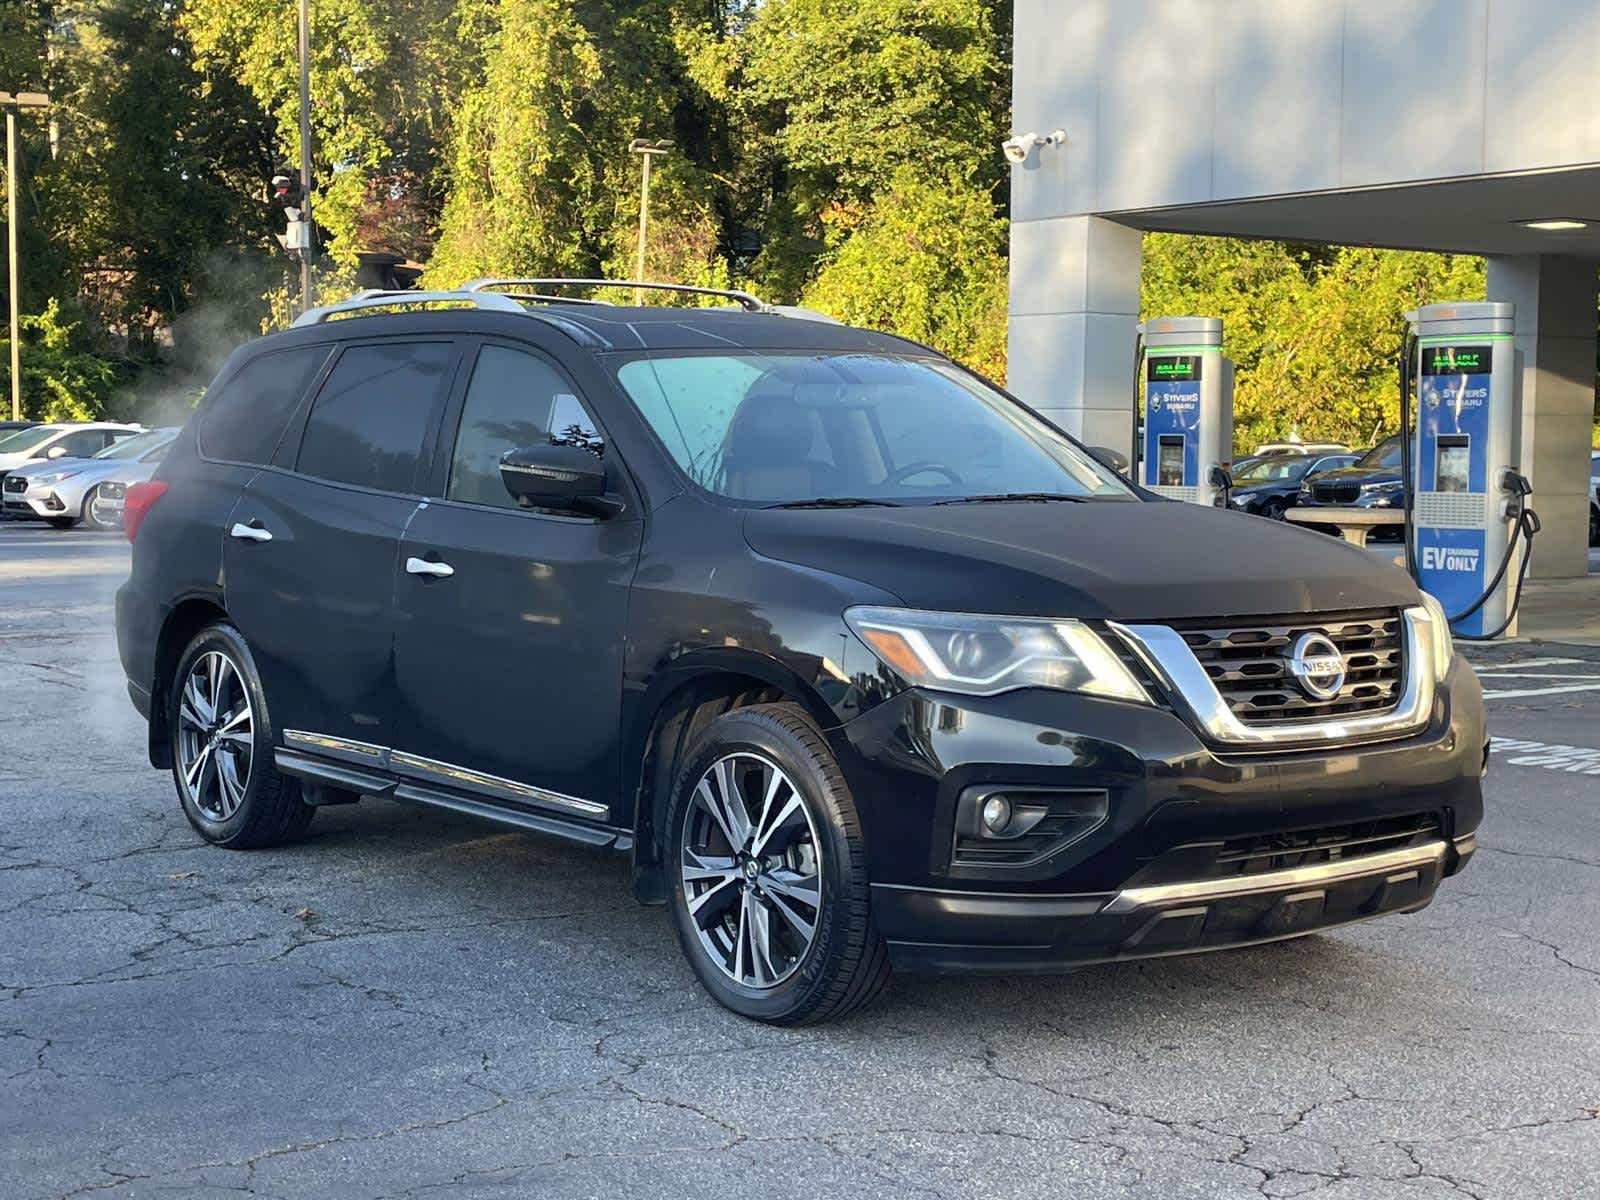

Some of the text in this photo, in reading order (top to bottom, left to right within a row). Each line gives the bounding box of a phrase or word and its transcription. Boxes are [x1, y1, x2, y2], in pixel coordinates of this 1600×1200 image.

[1442, 387, 1488, 398] STERS
[1447, 398, 1483, 407] SUARU
[1423, 546, 1447, 570] EV
[1447, 557, 1479, 572] ONLY
[1302, 661, 1345, 673] NISSAN
